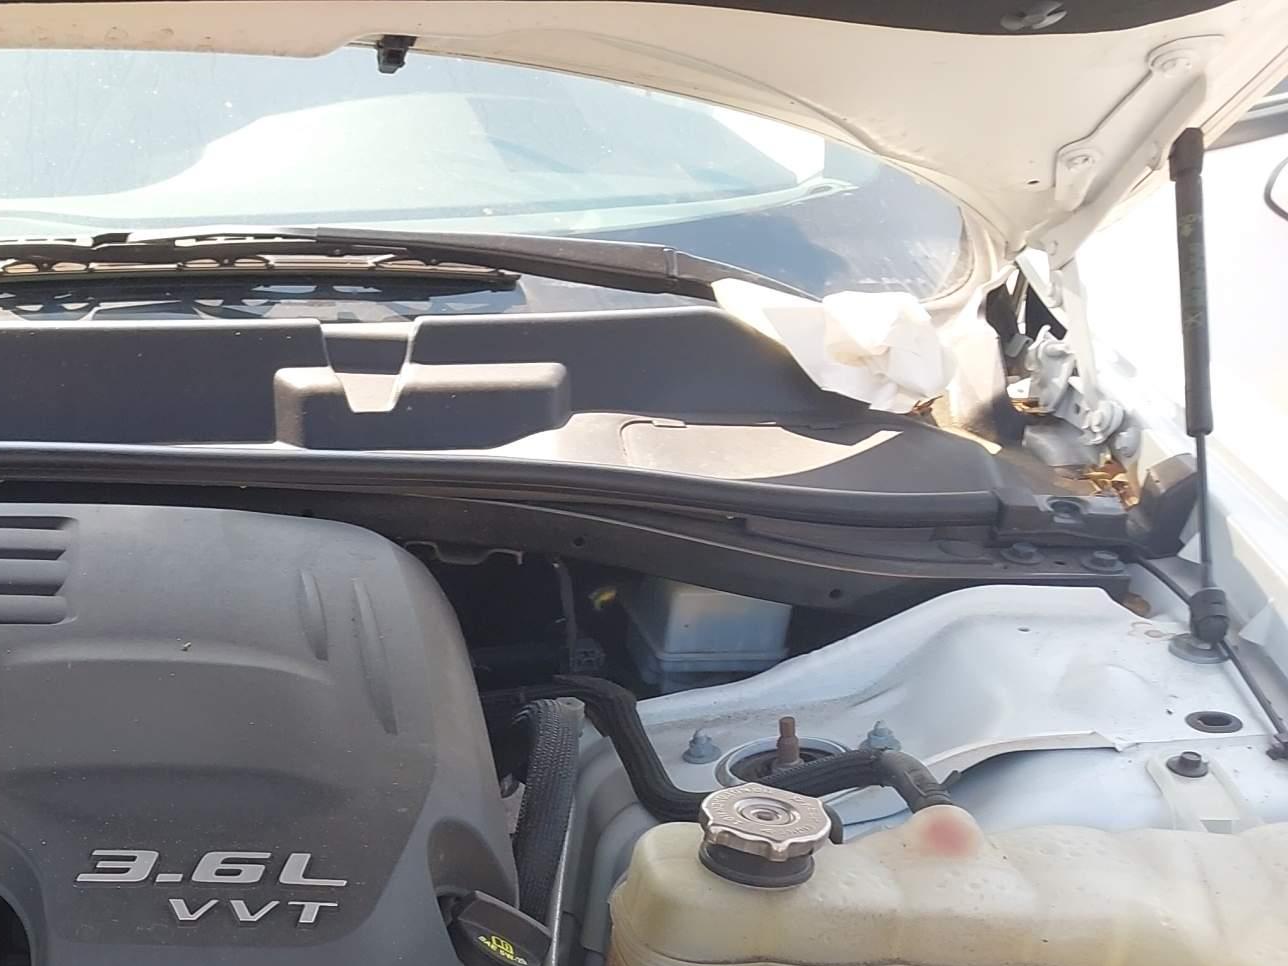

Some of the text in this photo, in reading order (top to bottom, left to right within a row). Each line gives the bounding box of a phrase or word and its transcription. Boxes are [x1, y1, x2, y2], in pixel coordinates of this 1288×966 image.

[76, 850, 348, 887] 3.6L
[168, 898, 339, 924] VVT
[477, 935, 498, 952] SAE
